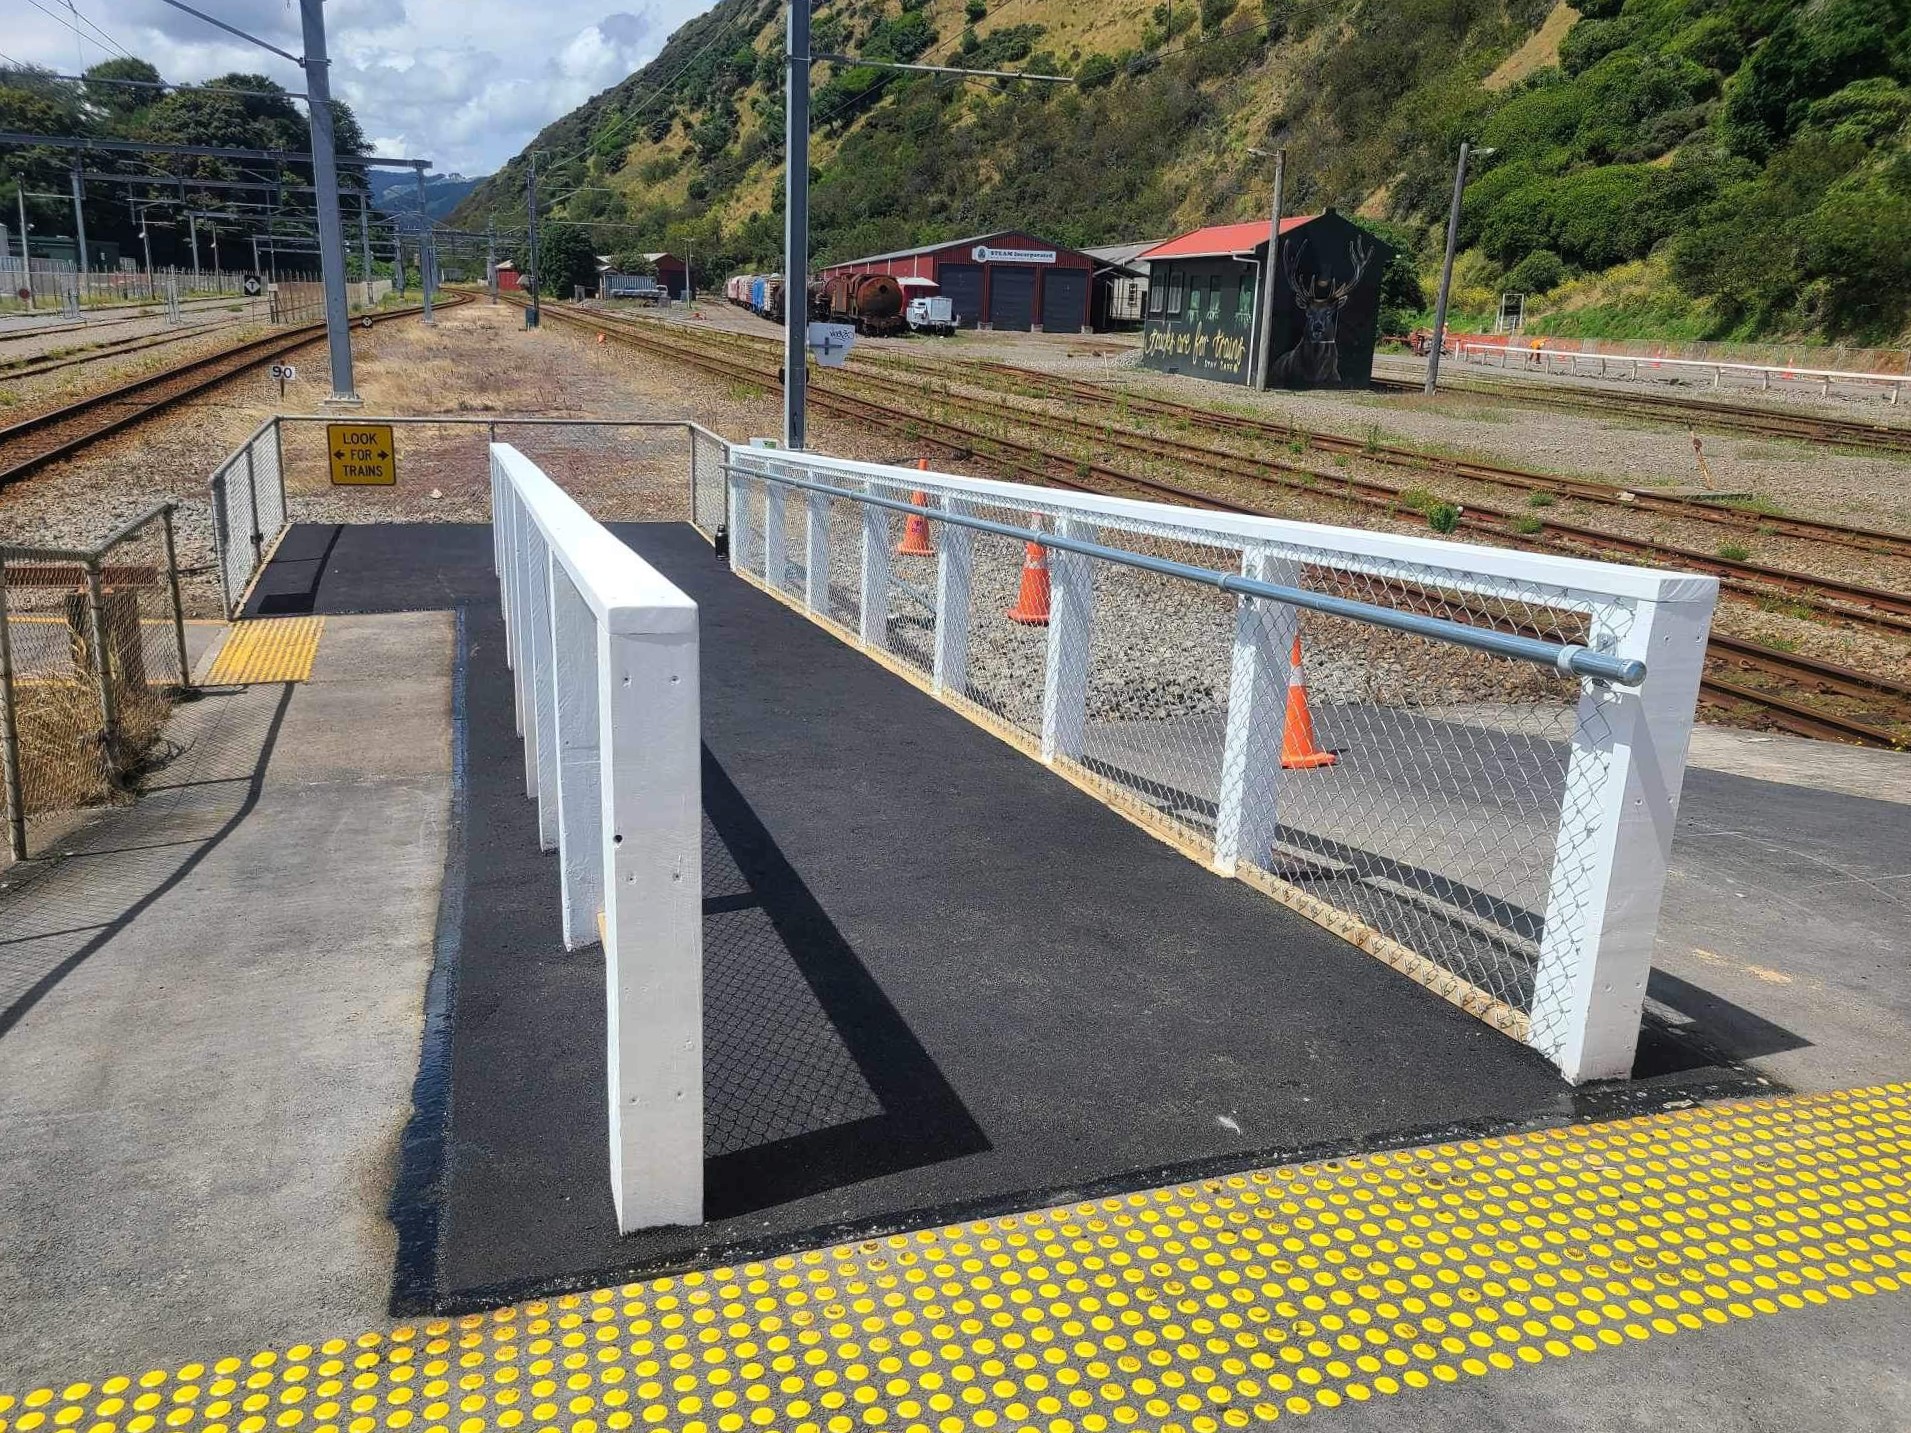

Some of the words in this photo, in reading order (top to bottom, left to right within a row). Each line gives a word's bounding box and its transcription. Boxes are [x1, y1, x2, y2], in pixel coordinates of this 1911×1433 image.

[248, 281, 256, 290] T
[1177, 333, 1192, 355] are
[1193, 321, 1209, 365] for
[272, 365, 293, 379] 90
[343, 432, 378, 445] LOOK
[350, 448, 373, 461] FOR
[342, 464, 383, 477] TRAINS
